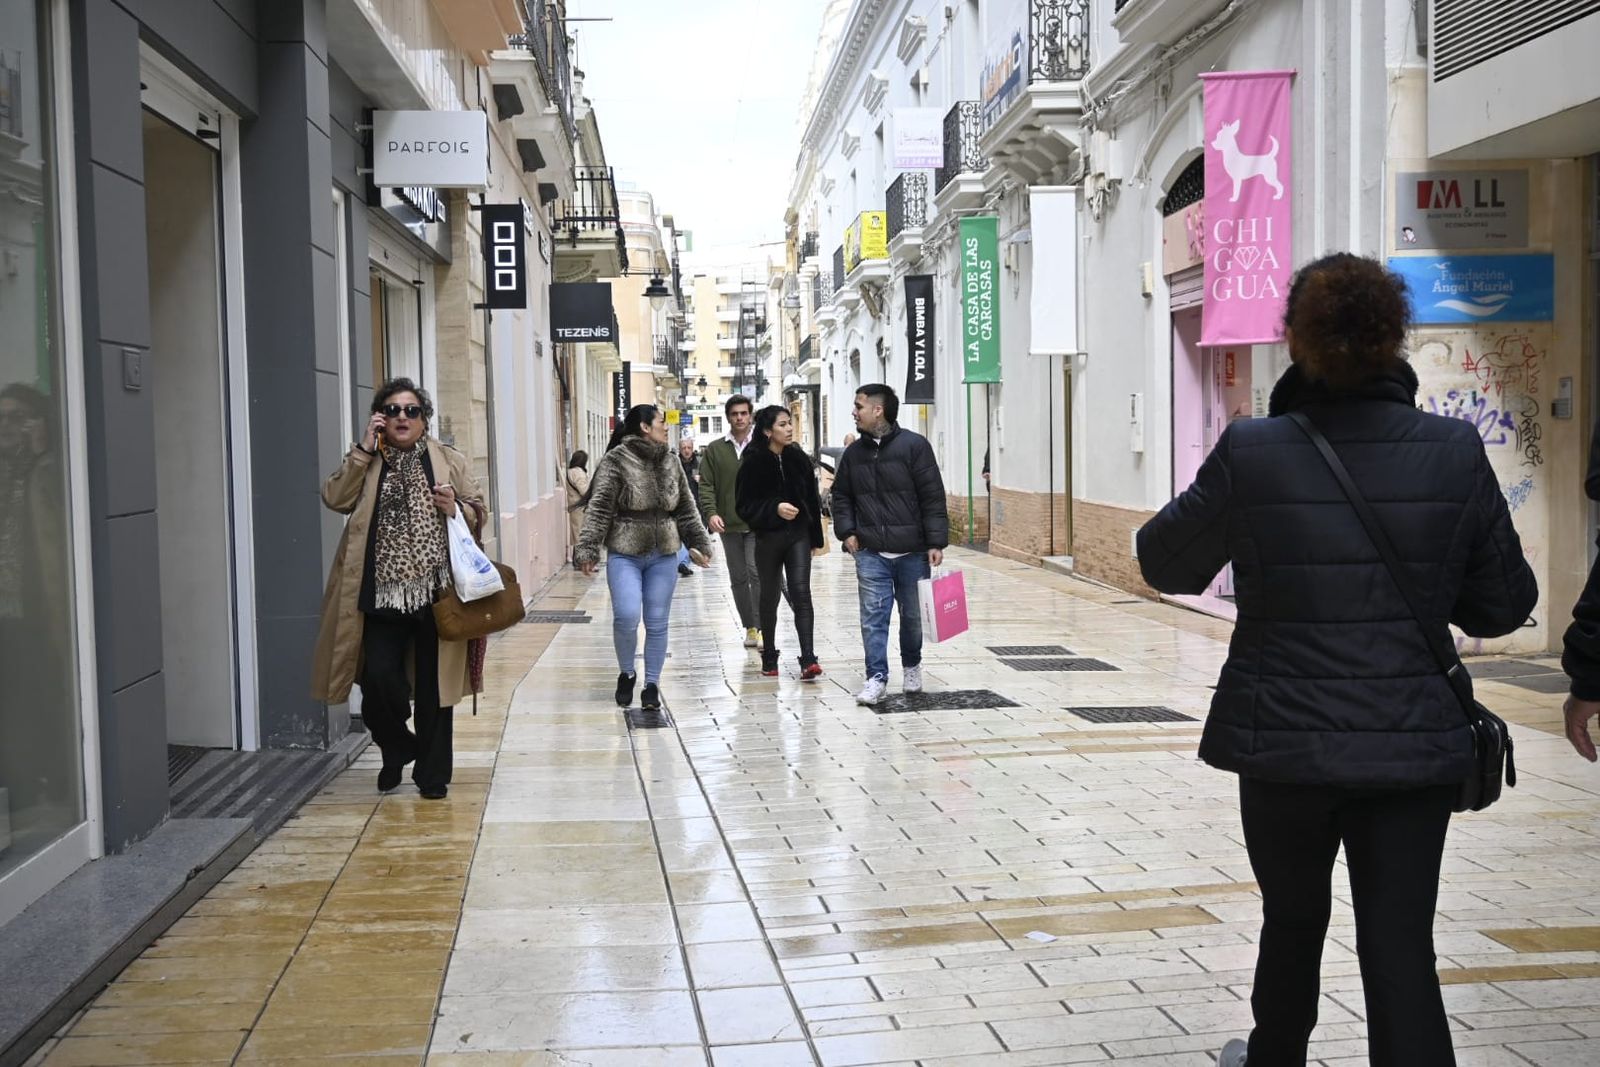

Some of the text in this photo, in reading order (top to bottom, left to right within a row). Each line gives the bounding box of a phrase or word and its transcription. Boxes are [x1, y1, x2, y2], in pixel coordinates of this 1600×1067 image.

[388, 141, 469, 154] PARFOIS
[1213, 216, 1273, 245] CHI
[1212, 274, 1280, 302] GUA
[1432, 279, 1514, 294] Ángel Muriel
[1441, 268, 1505, 281] Fundación
[966, 237, 980, 362] LA CASA DE LAS
[980, 260, 992, 341] CARCASAS
[914, 297, 926, 381] BIMBA Y LOLA
